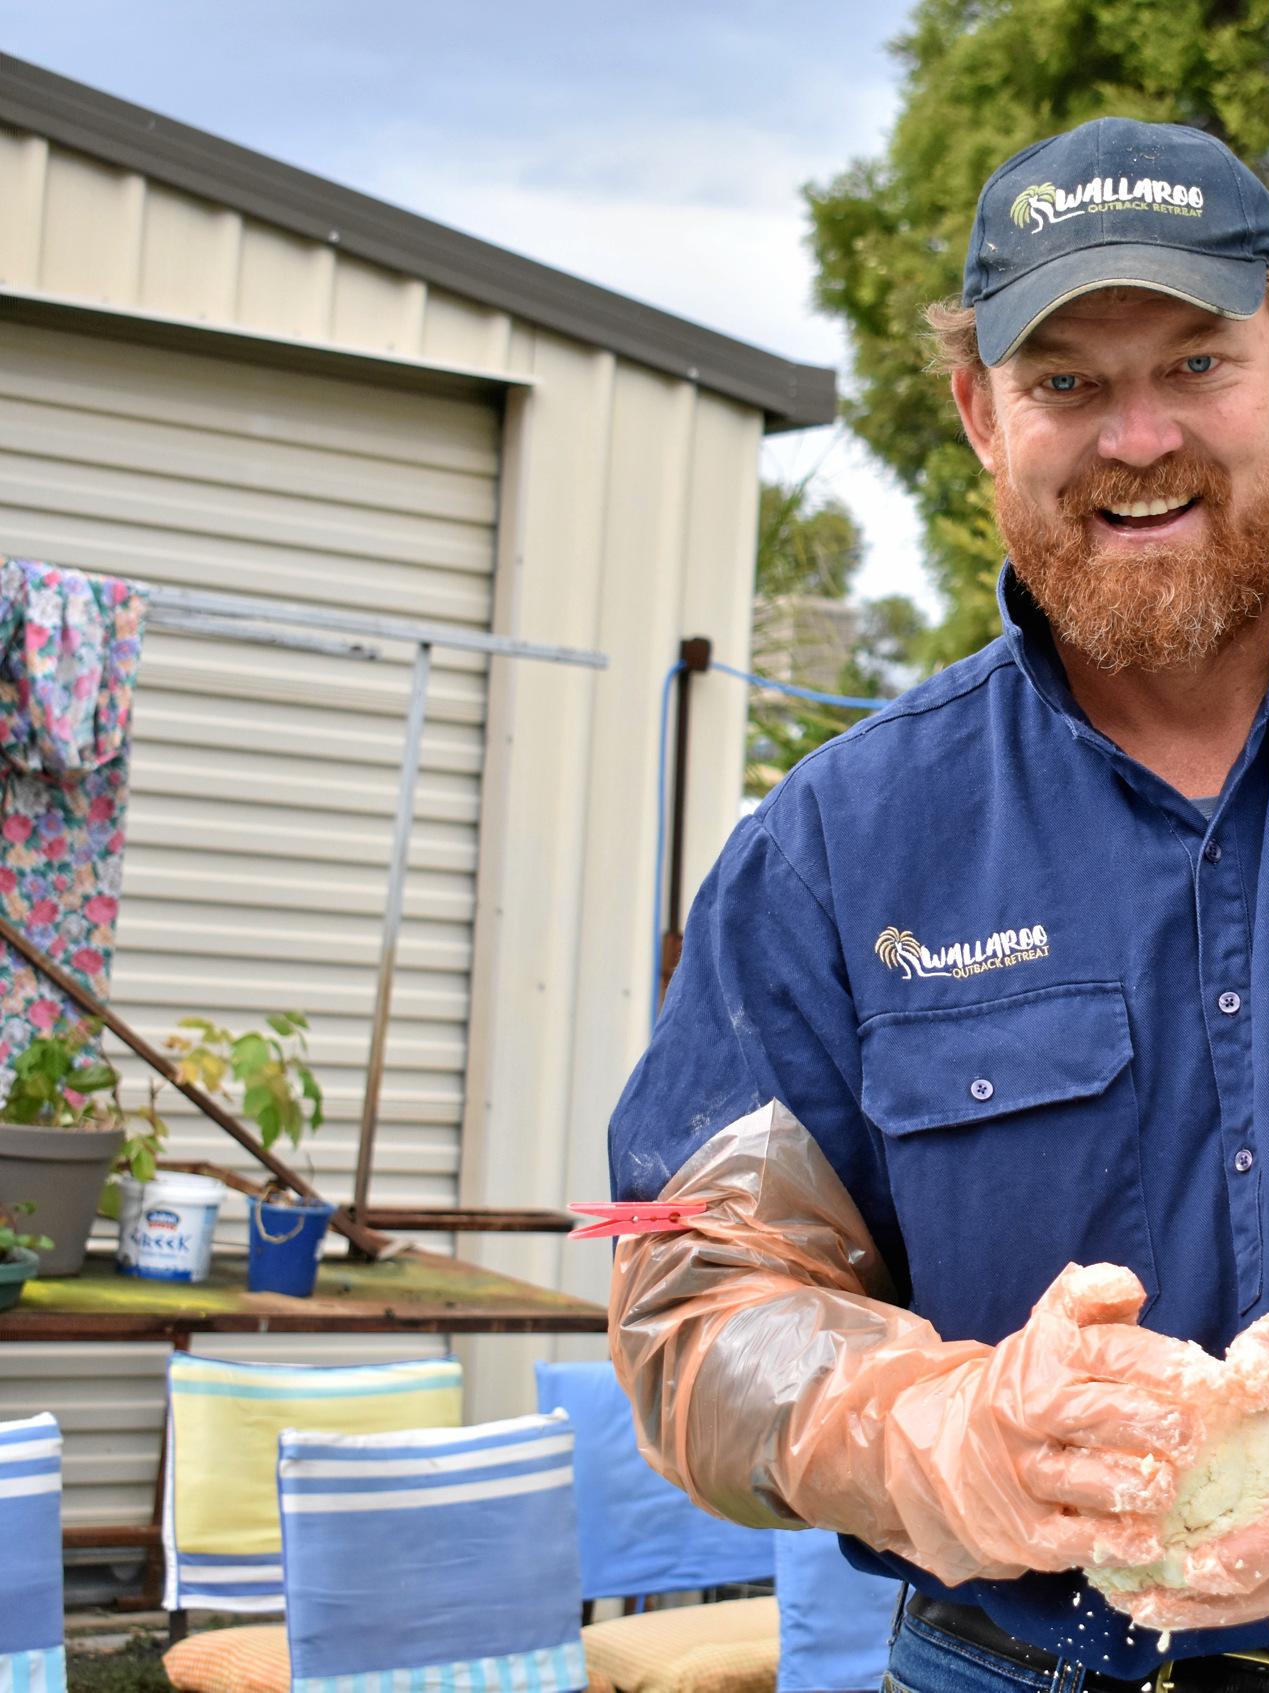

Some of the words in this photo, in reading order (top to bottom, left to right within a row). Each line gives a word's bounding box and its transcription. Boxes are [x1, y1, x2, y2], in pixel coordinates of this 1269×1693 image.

[1055, 177, 1204, 212] WALLAROO
[1087, 201, 1149, 213] OUTBACK
[1152, 202, 1204, 218] RETREAT
[920, 924, 1048, 969] WALLAROO
[952, 957, 1003, 979] OUTBACK
[1004, 945, 1050, 967] RETREAT
